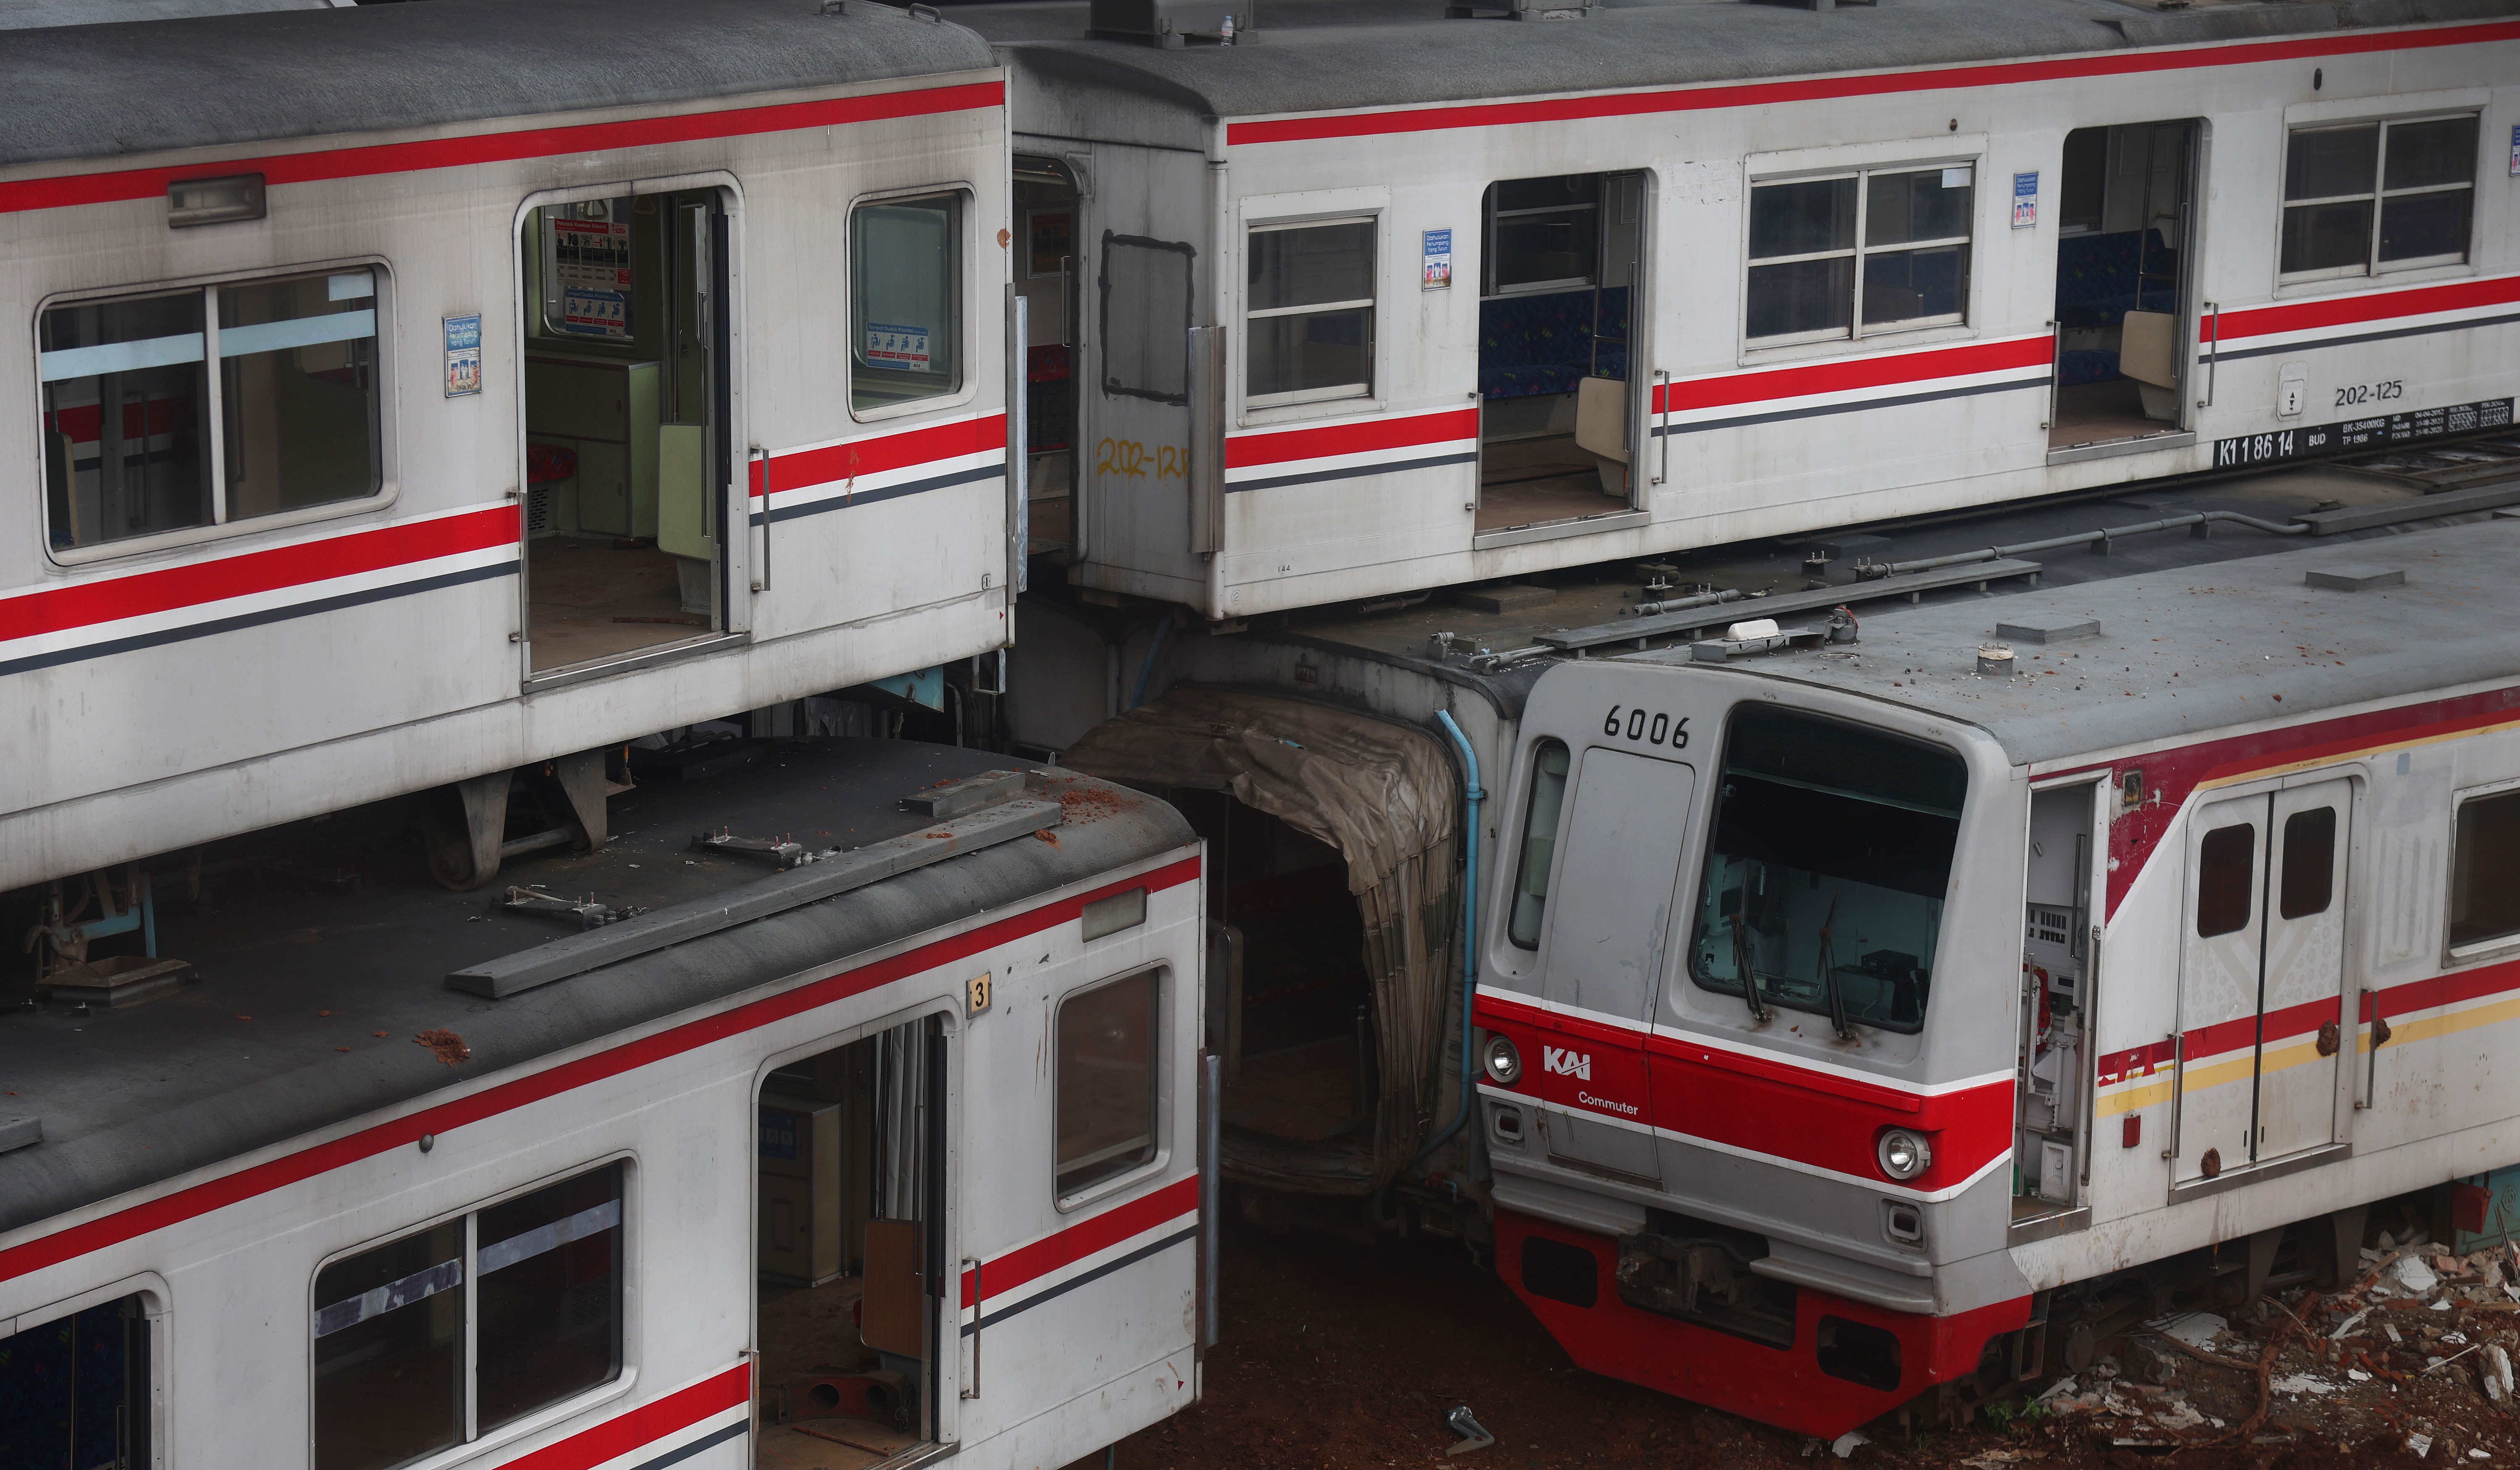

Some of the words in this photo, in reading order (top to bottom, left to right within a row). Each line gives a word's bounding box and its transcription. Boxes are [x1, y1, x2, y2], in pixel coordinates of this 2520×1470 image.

[450, 323, 477, 331] Dahulukan
[2335, 380, 2402, 407] 202-125
[2220, 439, 2236, 466] K1
[2242, 437, 2249, 462] 1
[2254, 433, 2273, 461] 86
[2278, 430, 2293, 457] 14
[2309, 433, 2326, 446] BUD
[2342, 436, 2351, 446] TP
[2353, 433, 2369, 444] 1986
[1604, 705, 1690, 749] 6006
[975, 982, 984, 1007] 3
[1544, 1045, 1591, 1081] KAI
[1578, 1091, 1638, 1116] Commuter
